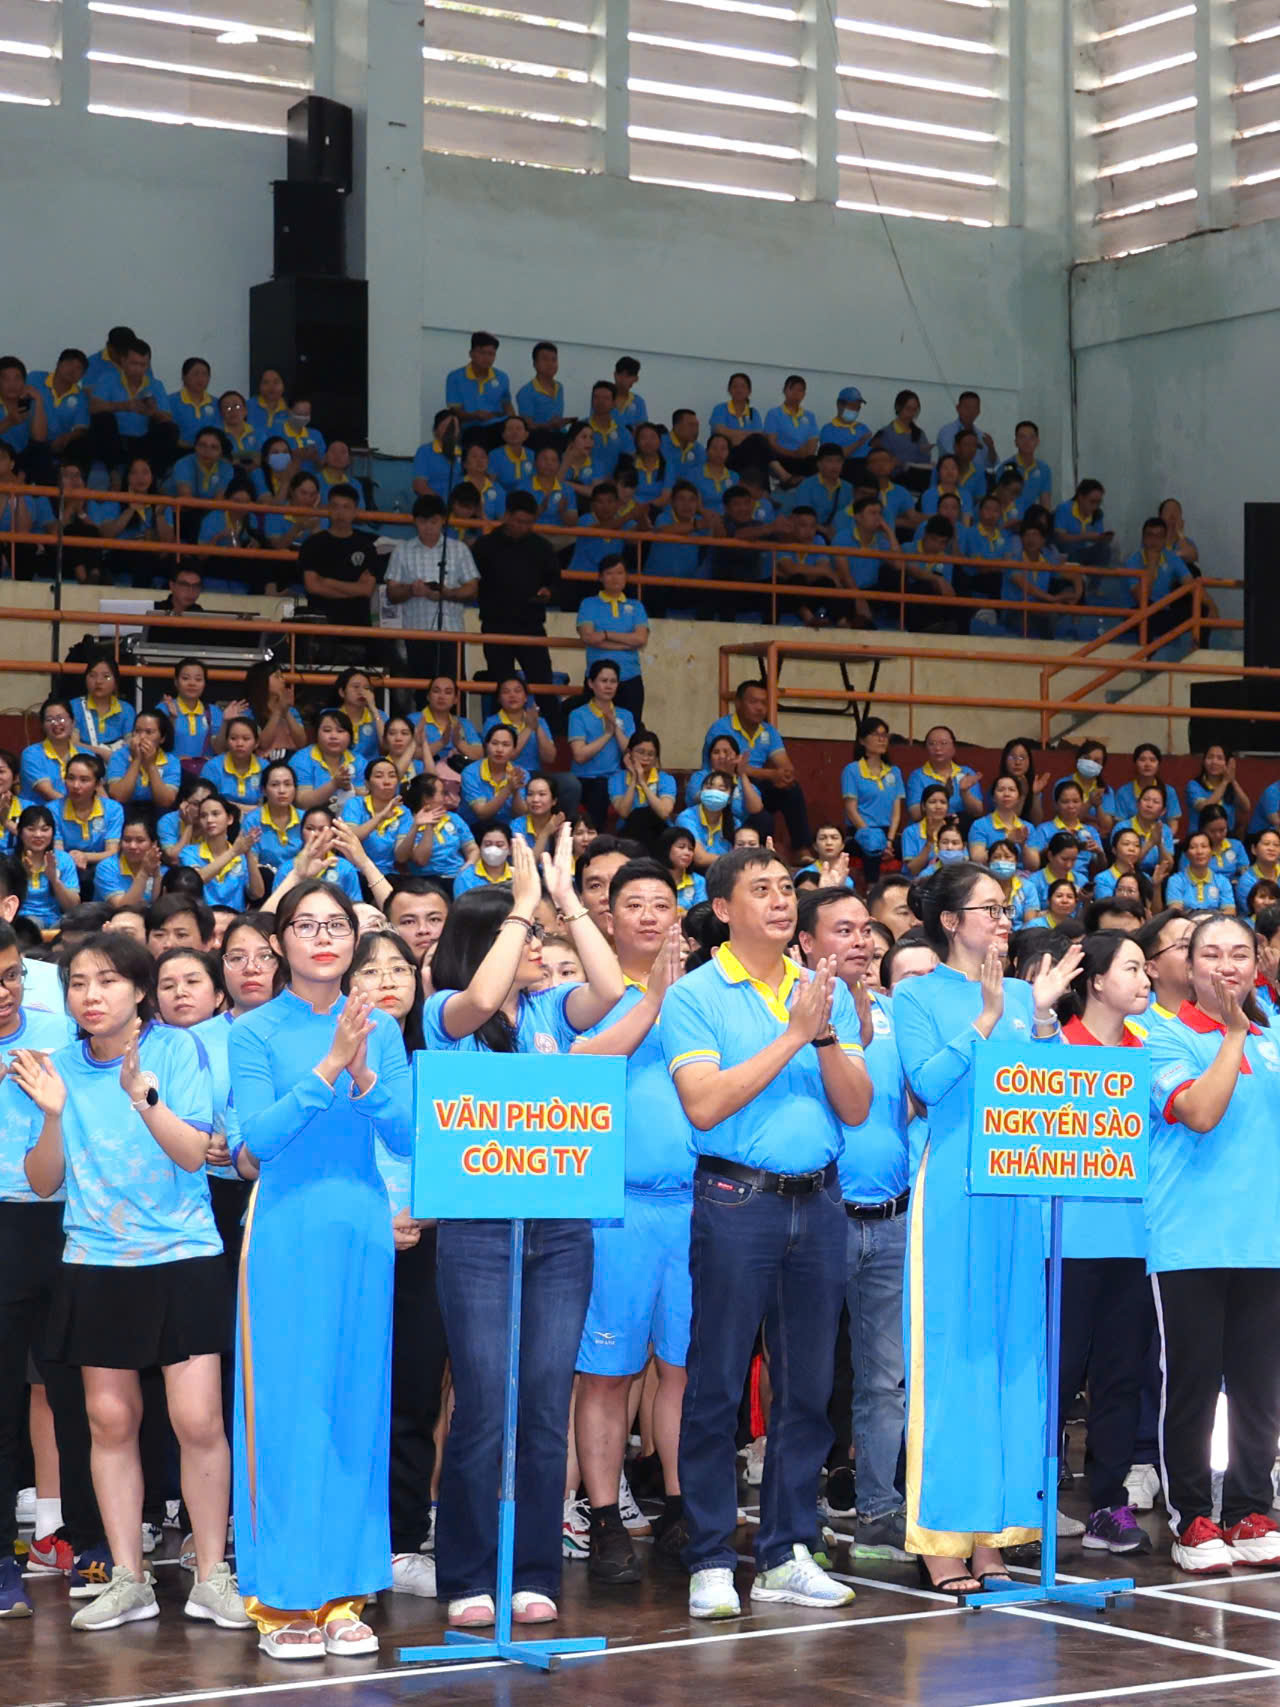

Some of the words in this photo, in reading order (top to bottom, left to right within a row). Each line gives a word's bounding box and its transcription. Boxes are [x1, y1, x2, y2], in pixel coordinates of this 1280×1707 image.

[995, 1063, 1064, 1095] CÔNG
[1069, 1071, 1099, 1096] TY
[1103, 1073, 1133, 1097] CP
[434, 1096, 499, 1130] VĂN
[506, 1097, 612, 1131] PHÒNG
[985, 1108, 1037, 1134] NGK
[1042, 1104, 1087, 1137] YẾN
[1094, 1107, 1142, 1138] SÀO
[463, 1141, 547, 1174] CÔNG
[553, 1147, 591, 1175] TY
[989, 1146, 1077, 1177] KHÁNH
[1083, 1149, 1135, 1178] HÒA
